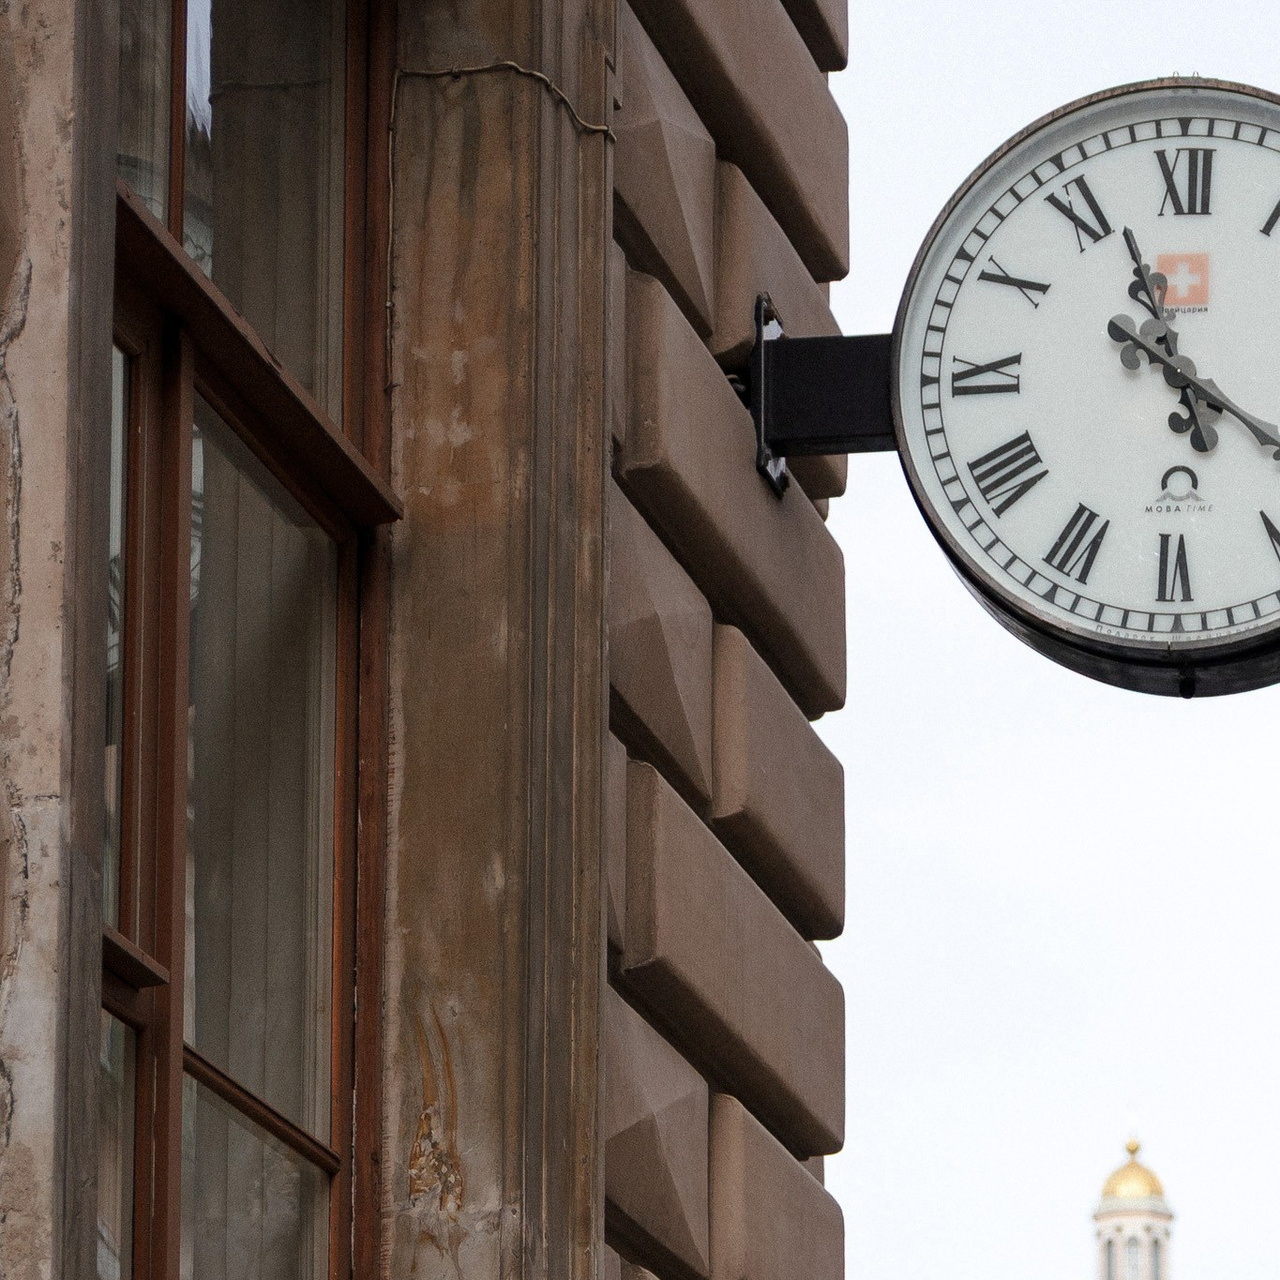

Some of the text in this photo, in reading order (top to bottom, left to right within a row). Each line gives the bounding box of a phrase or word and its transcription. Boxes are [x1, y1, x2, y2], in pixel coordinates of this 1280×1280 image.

[1044, 174, 1115, 253] XI
[1153, 148, 1217, 217] XII
[977, 256, 1051, 309] X
[1161, 306, 1208, 314] вейцария
[952, 352, 1022, 398] IX
[966, 430, 1050, 519] VIII
[1042, 502, 1110, 585] VII
[1155, 533, 1194, 603] VI
